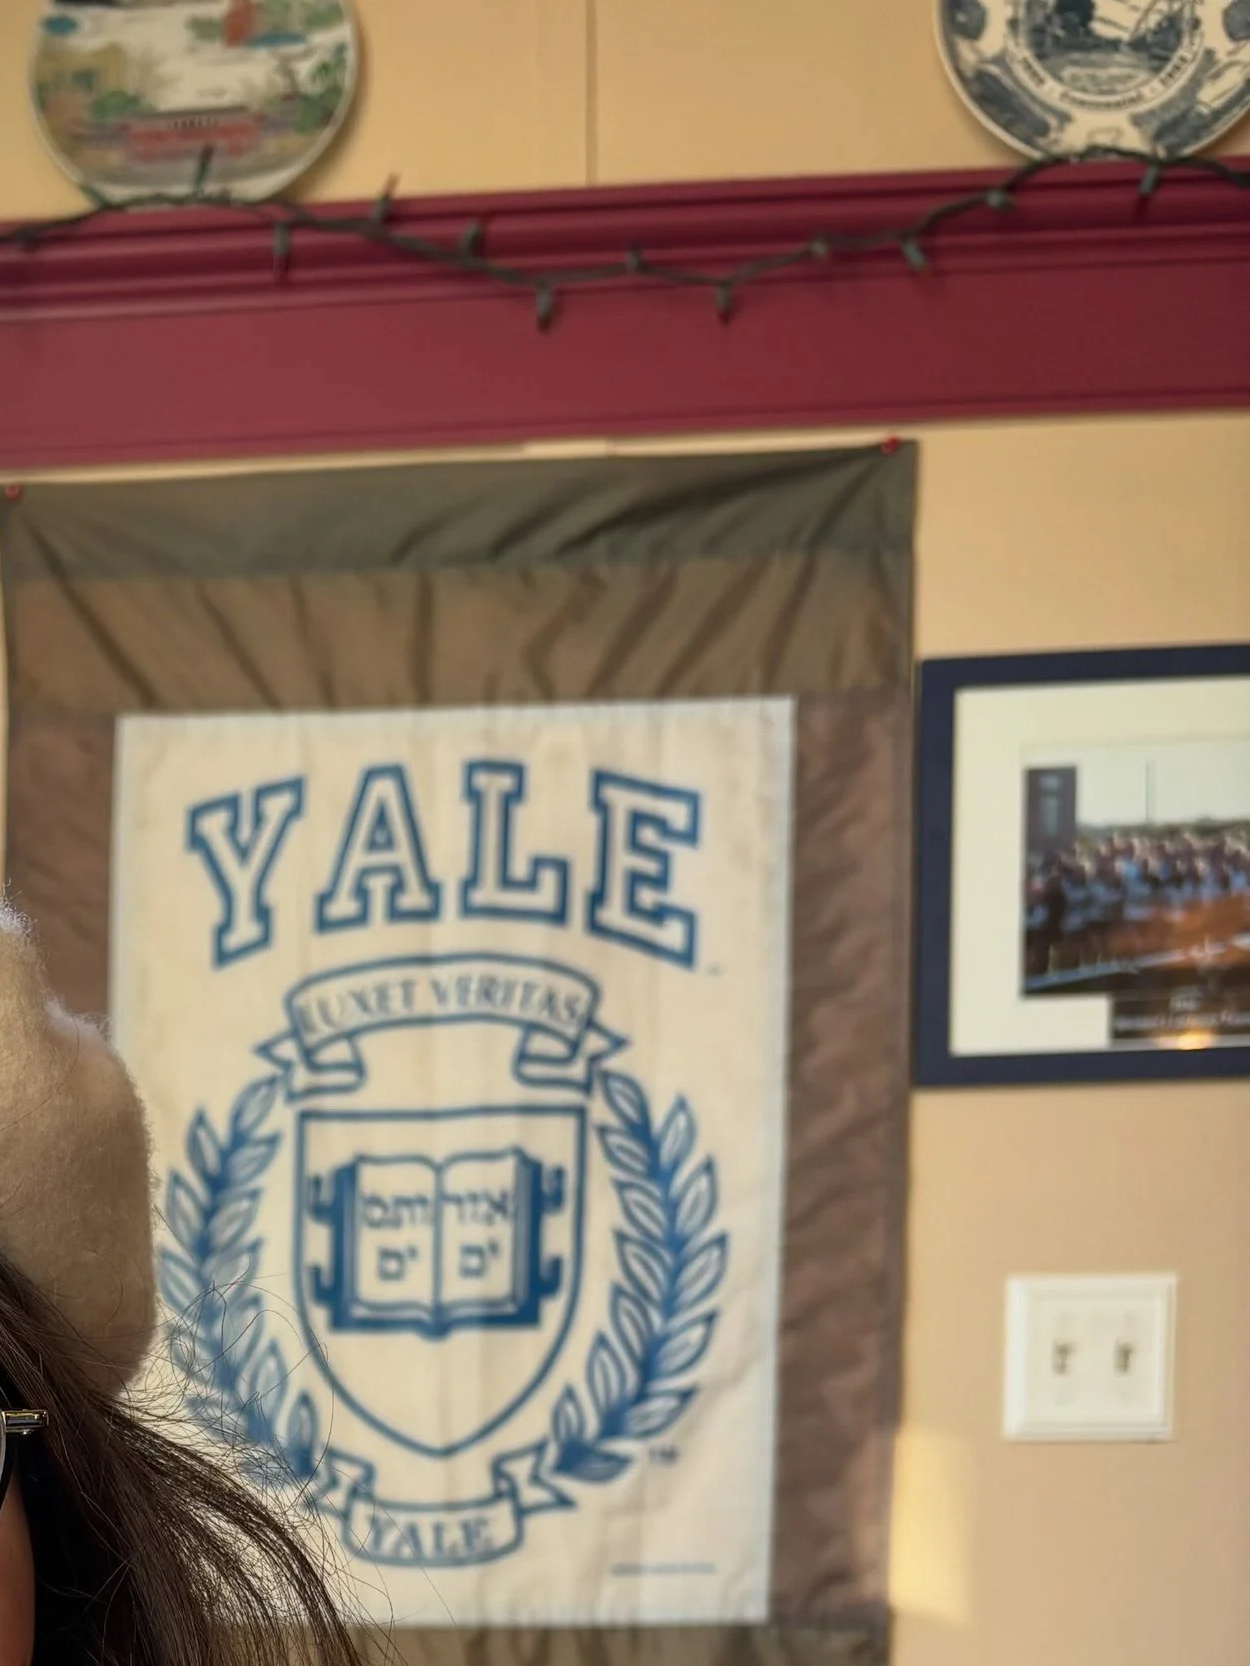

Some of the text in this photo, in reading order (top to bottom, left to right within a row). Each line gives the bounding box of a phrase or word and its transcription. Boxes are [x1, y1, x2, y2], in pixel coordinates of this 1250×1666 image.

[186, 758, 701, 970] YALE
[430, 973, 585, 1027] VERITAS
[365, 1514, 496, 1558] YALE
